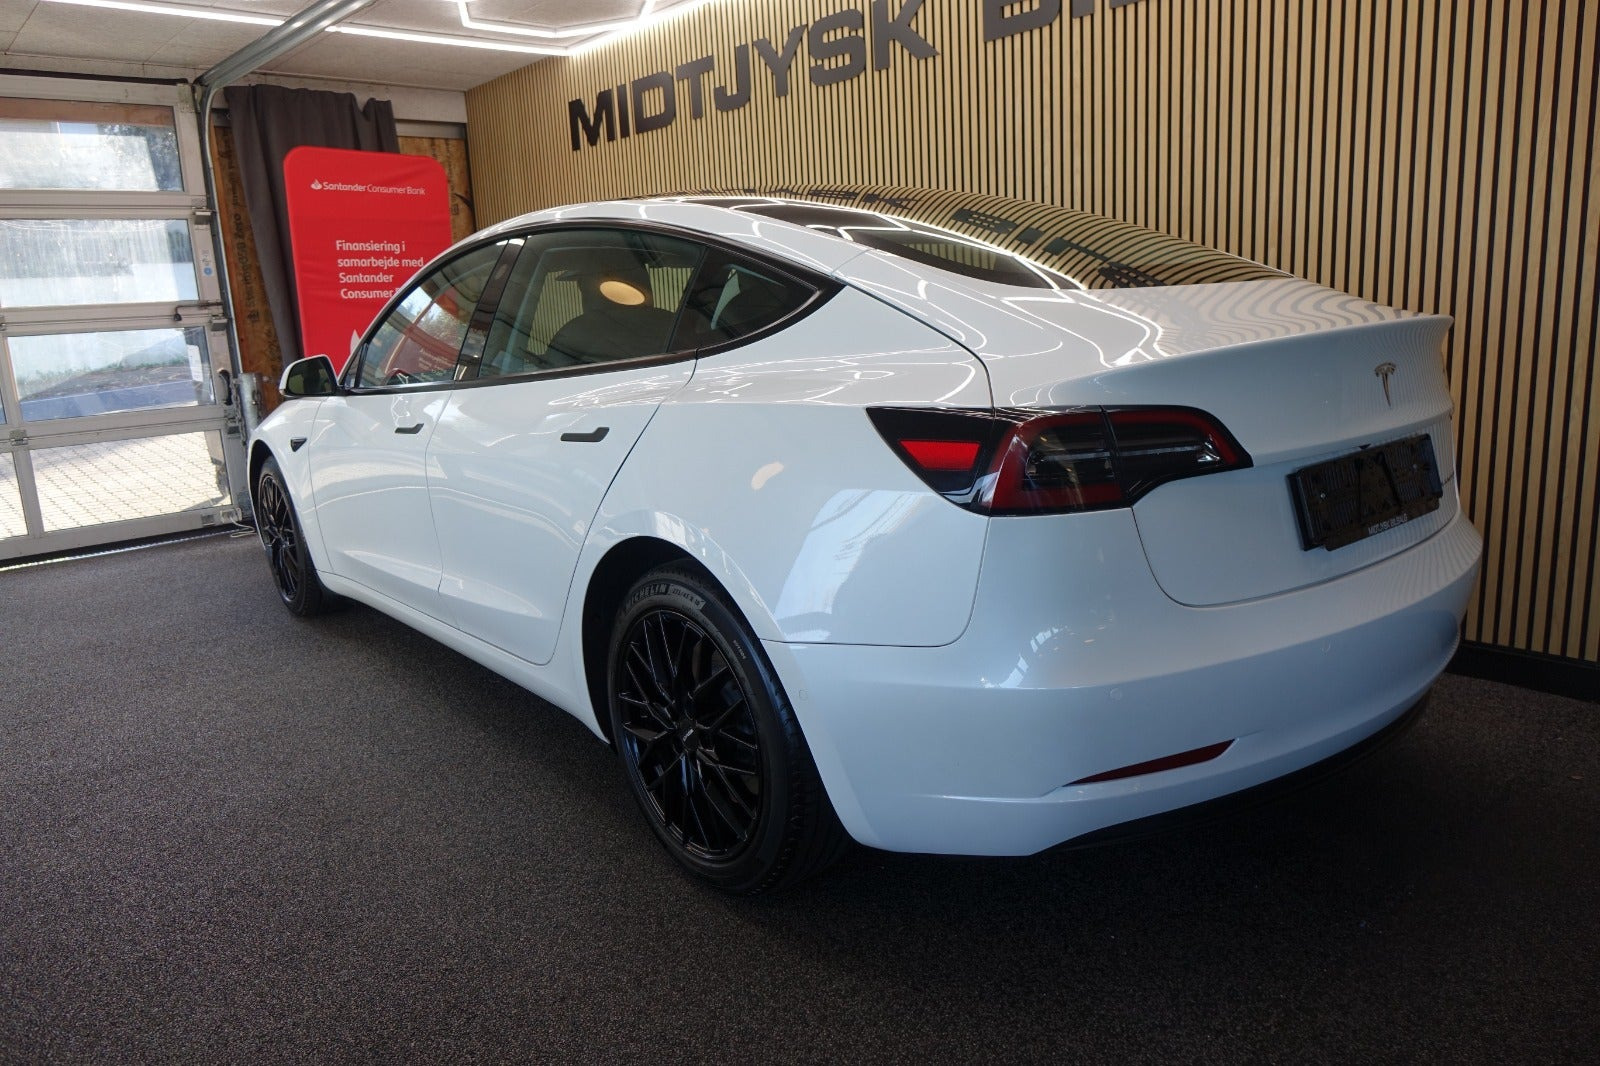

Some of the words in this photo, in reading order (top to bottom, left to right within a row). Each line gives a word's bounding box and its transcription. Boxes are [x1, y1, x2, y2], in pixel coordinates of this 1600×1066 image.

[567, 0, 939, 151] MIDTJYSK
[323, 182, 366, 191] Santander
[367, 184, 406, 194] Consumer
[407, 187, 425, 195] Bank
[335, 240, 400, 254] Finansiering
[402, 241, 405, 251] i
[337, 256, 400, 269] samarbejde
[401, 257, 424, 267] med
[339, 272, 394, 283] Santander
[340, 288, 393, 299] Consumer
